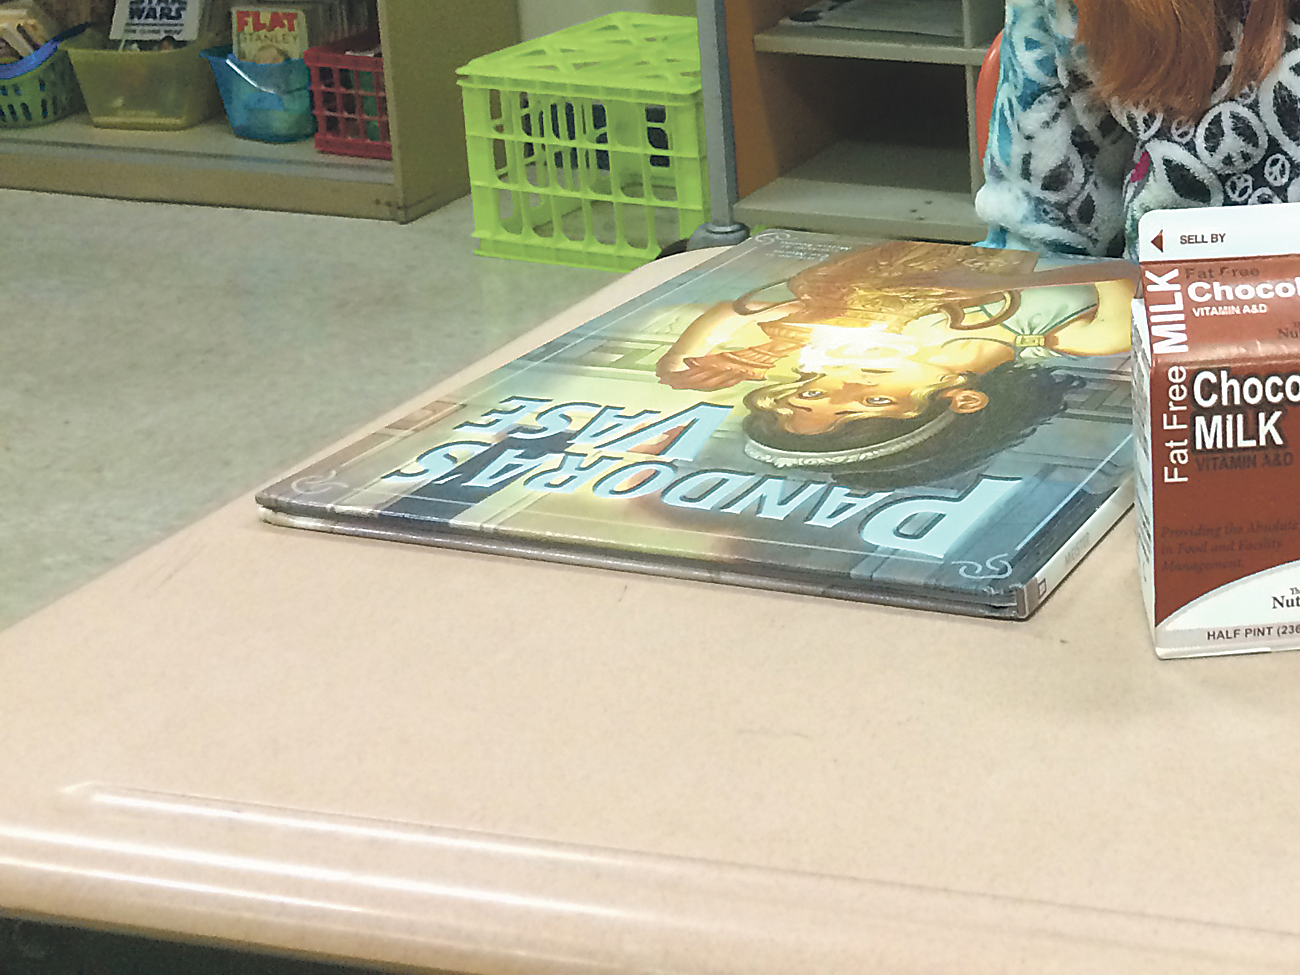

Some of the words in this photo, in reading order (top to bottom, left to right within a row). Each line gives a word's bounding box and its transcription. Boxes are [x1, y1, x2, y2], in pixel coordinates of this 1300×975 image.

[129, 6, 185, 21] WARS
[236, 10, 298, 33] FLAT
[1180, 234, 1208, 245] SELL
[1210, 233, 1226, 243] BY
[1185, 266, 1213, 279] Fat
[1219, 265, 1260, 277] Free
[1145, 269, 1189, 355] MILK
[1192, 305, 1241, 318] VITAMIN
[1242, 303, 1268, 314] A&D
[1163, 365, 1188, 430] Free
[453, 395, 735, 463] VASE
[1195, 410, 1284, 451] MILK
[1164, 438, 1189, 484] Fat
[1194, 455, 1258, 473] VITAMIN
[1262, 452, 1294, 467] A&D
[381, 439, 1023, 558] PANDORA'S
[1207, 630, 1241, 641] HALF
[1245, 627, 1274, 639] PINT
